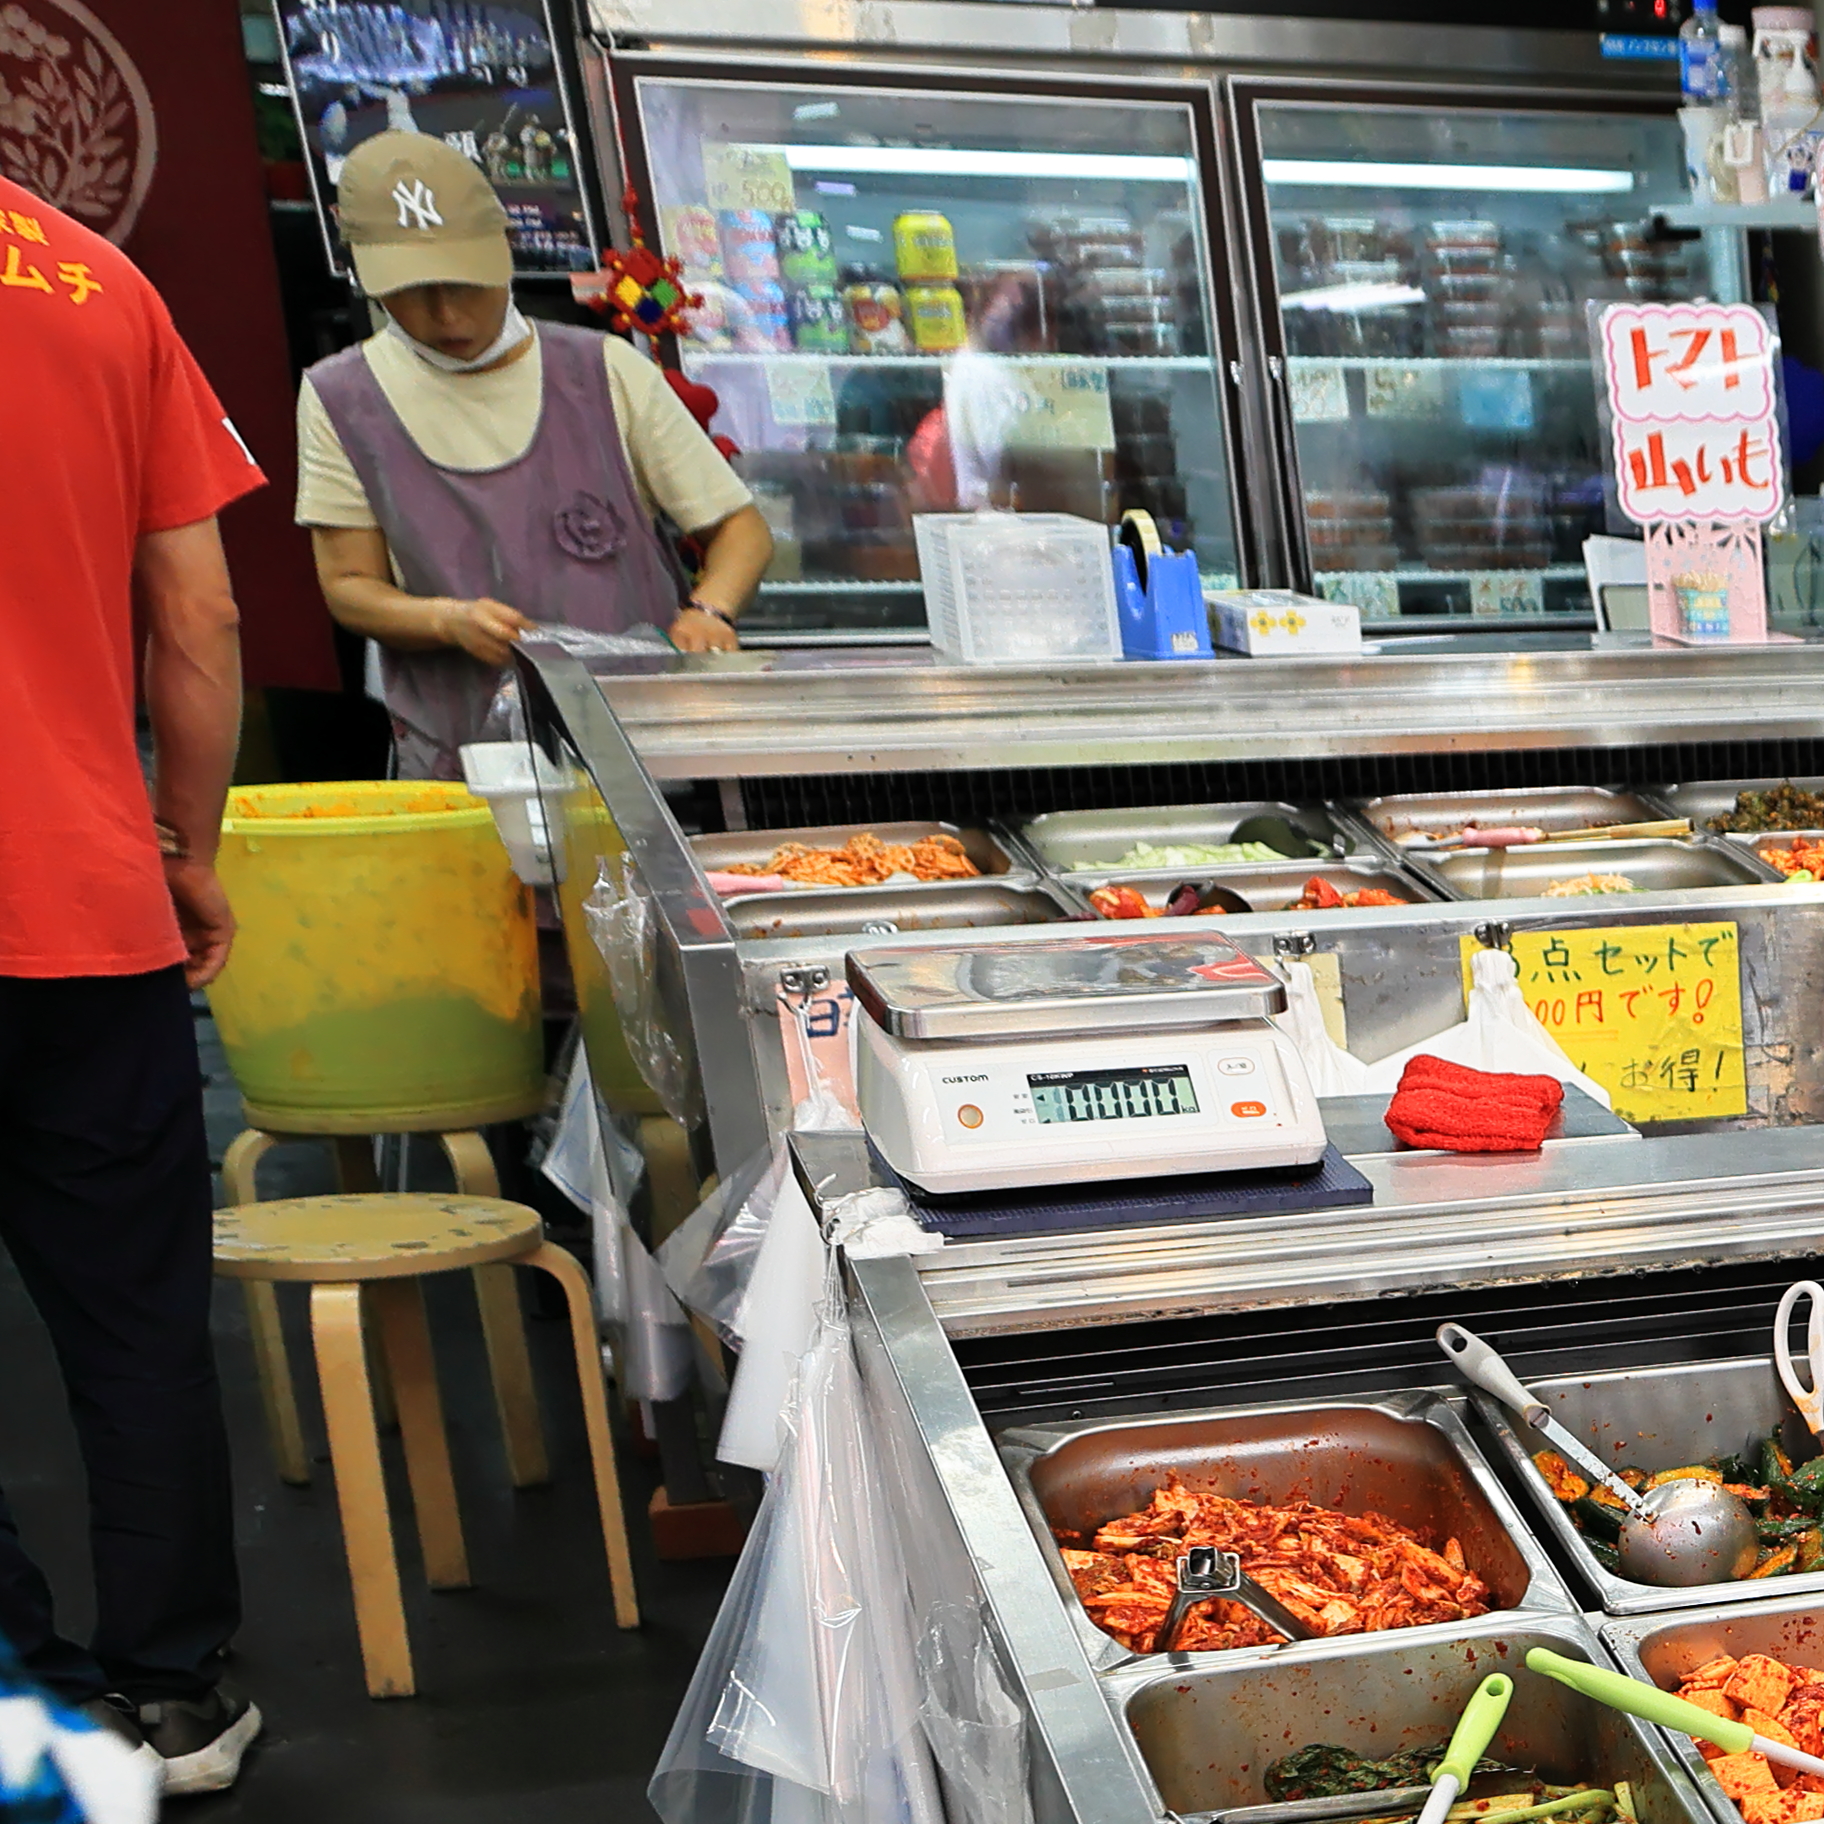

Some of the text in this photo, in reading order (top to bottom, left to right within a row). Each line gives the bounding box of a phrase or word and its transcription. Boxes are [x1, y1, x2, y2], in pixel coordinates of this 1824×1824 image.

[1630, 326, 1763, 391] トマト
[1628, 429, 1770, 497] 山いも
[942, 1073, 989, 1084] CUSTOM
